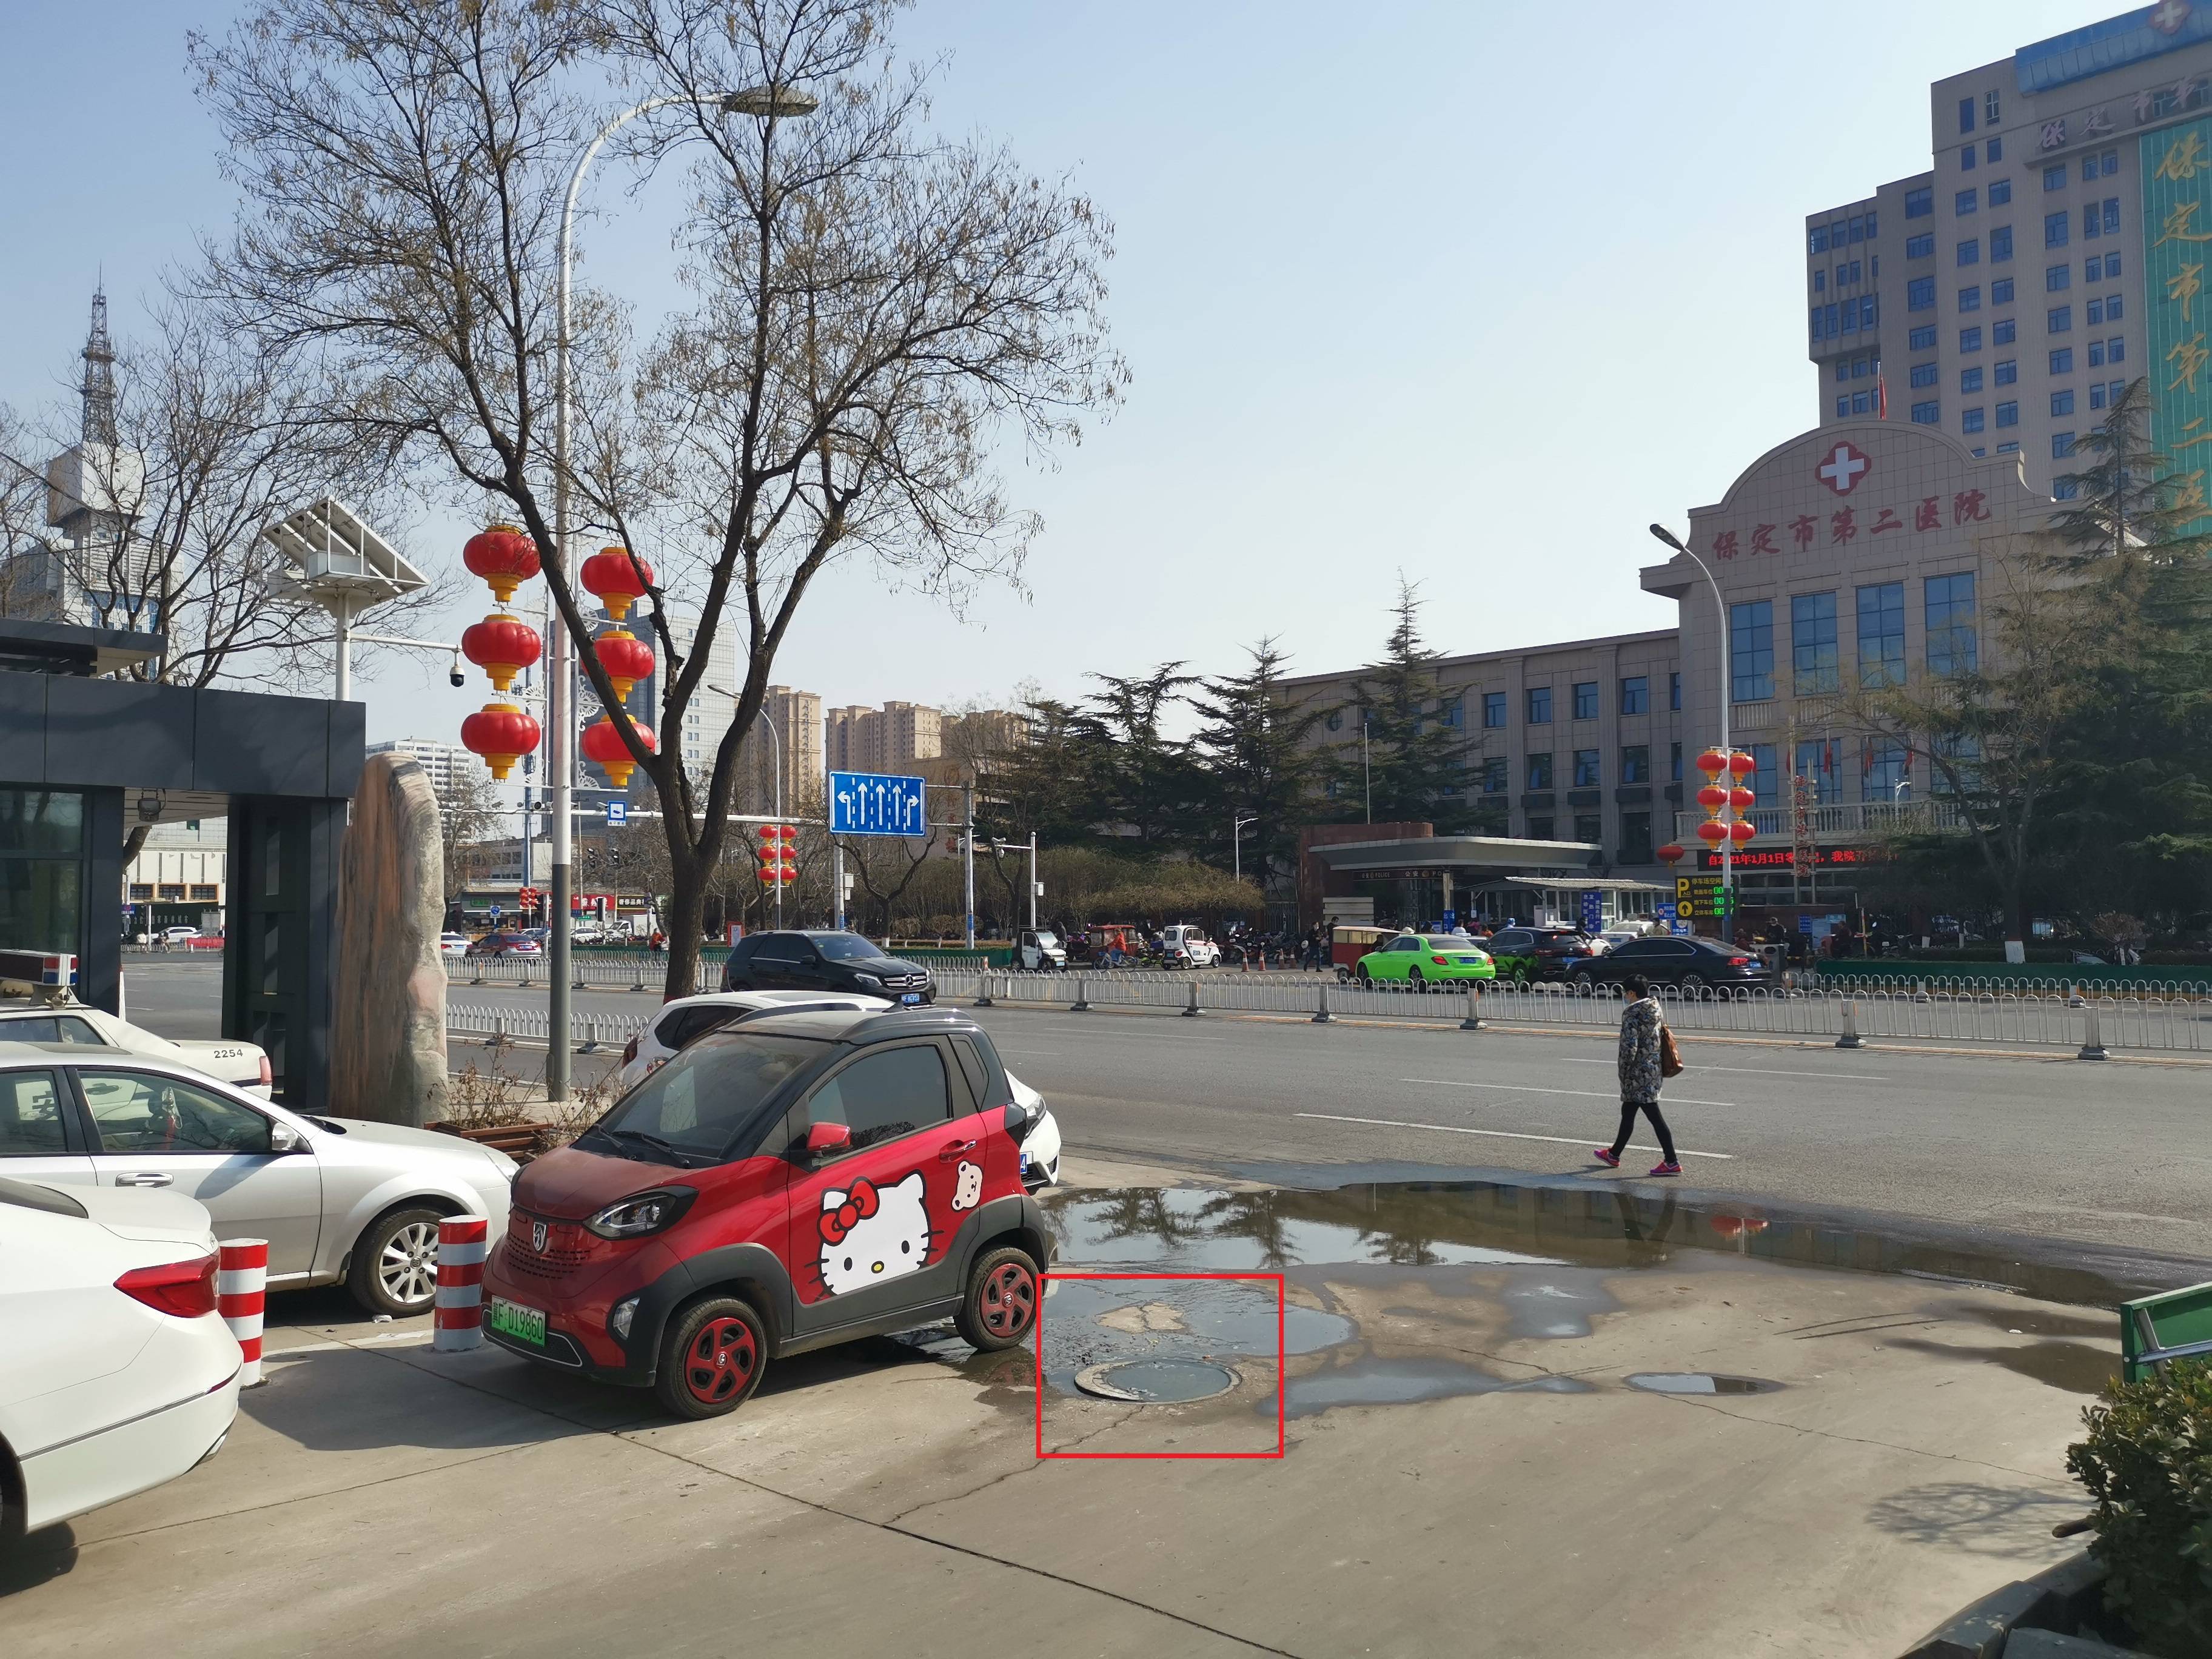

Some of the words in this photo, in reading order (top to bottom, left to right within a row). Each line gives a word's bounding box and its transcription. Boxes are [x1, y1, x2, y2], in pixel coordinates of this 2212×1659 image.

[1712, 489, 1991, 561] 保定市第二医院
[214, 1049, 243, 1058] 2254
